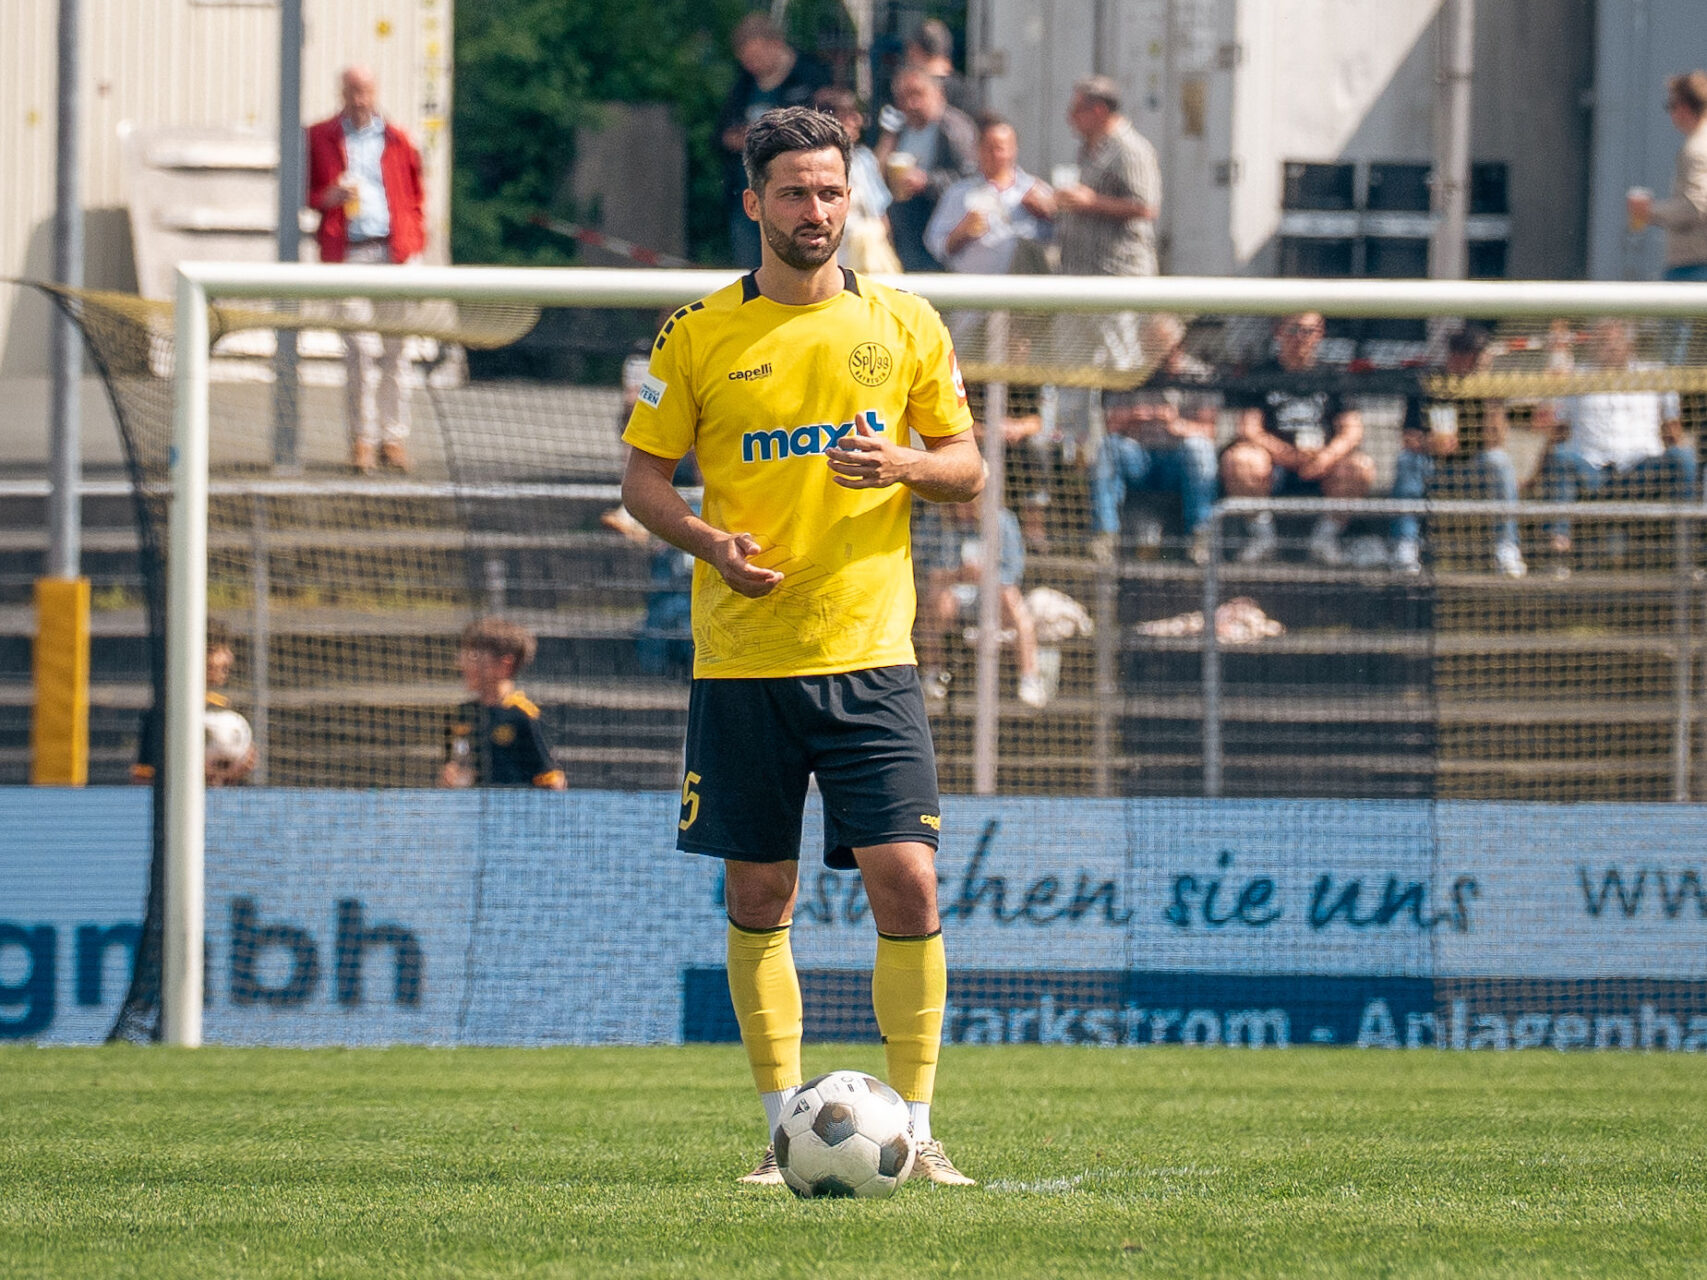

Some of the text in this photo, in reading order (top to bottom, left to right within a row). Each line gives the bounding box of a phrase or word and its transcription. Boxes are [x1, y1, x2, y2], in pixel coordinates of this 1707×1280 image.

[728, 362, 772, 381] capelli
[743, 411, 884, 462] maxt
[678, 770, 702, 831] 5
[1164, 848, 1282, 929] sie
[1307, 870, 1481, 933] uns
